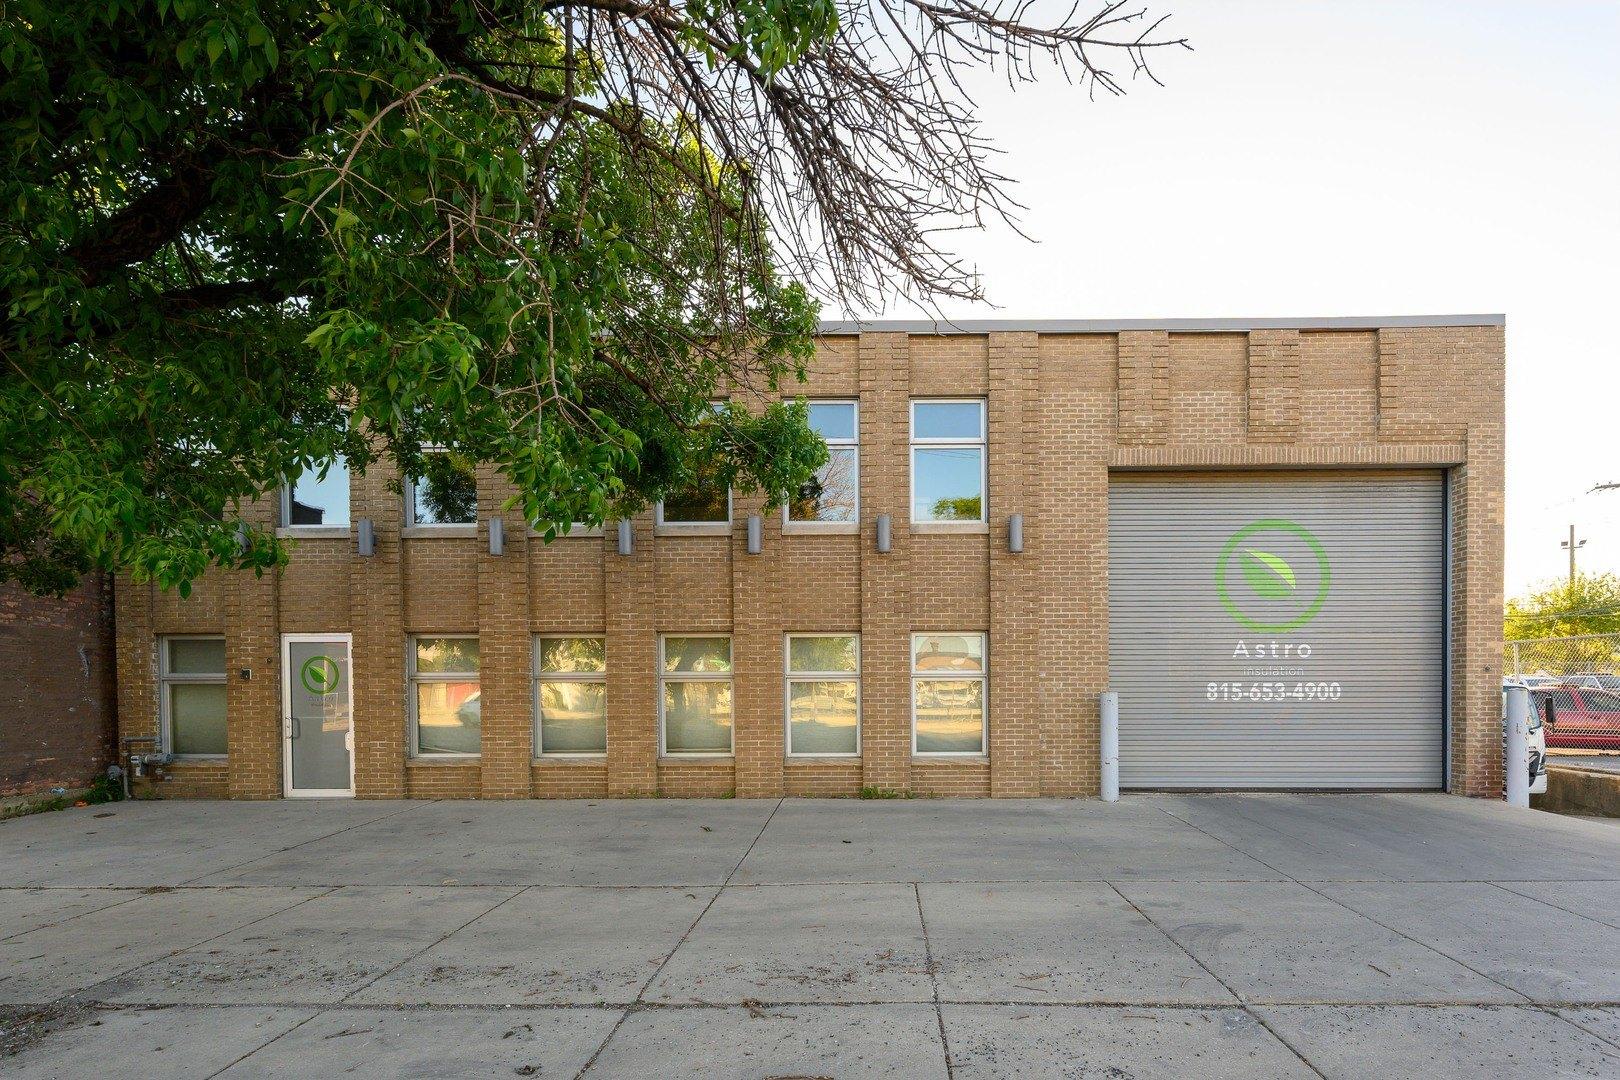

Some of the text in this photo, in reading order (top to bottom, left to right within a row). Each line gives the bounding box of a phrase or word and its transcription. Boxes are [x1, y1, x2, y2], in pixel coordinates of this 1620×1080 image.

[1232, 640, 1312, 658] Astro
[1243, 666, 1304, 676] insulation
[1206, 682, 1341, 701] 815-653-4900
